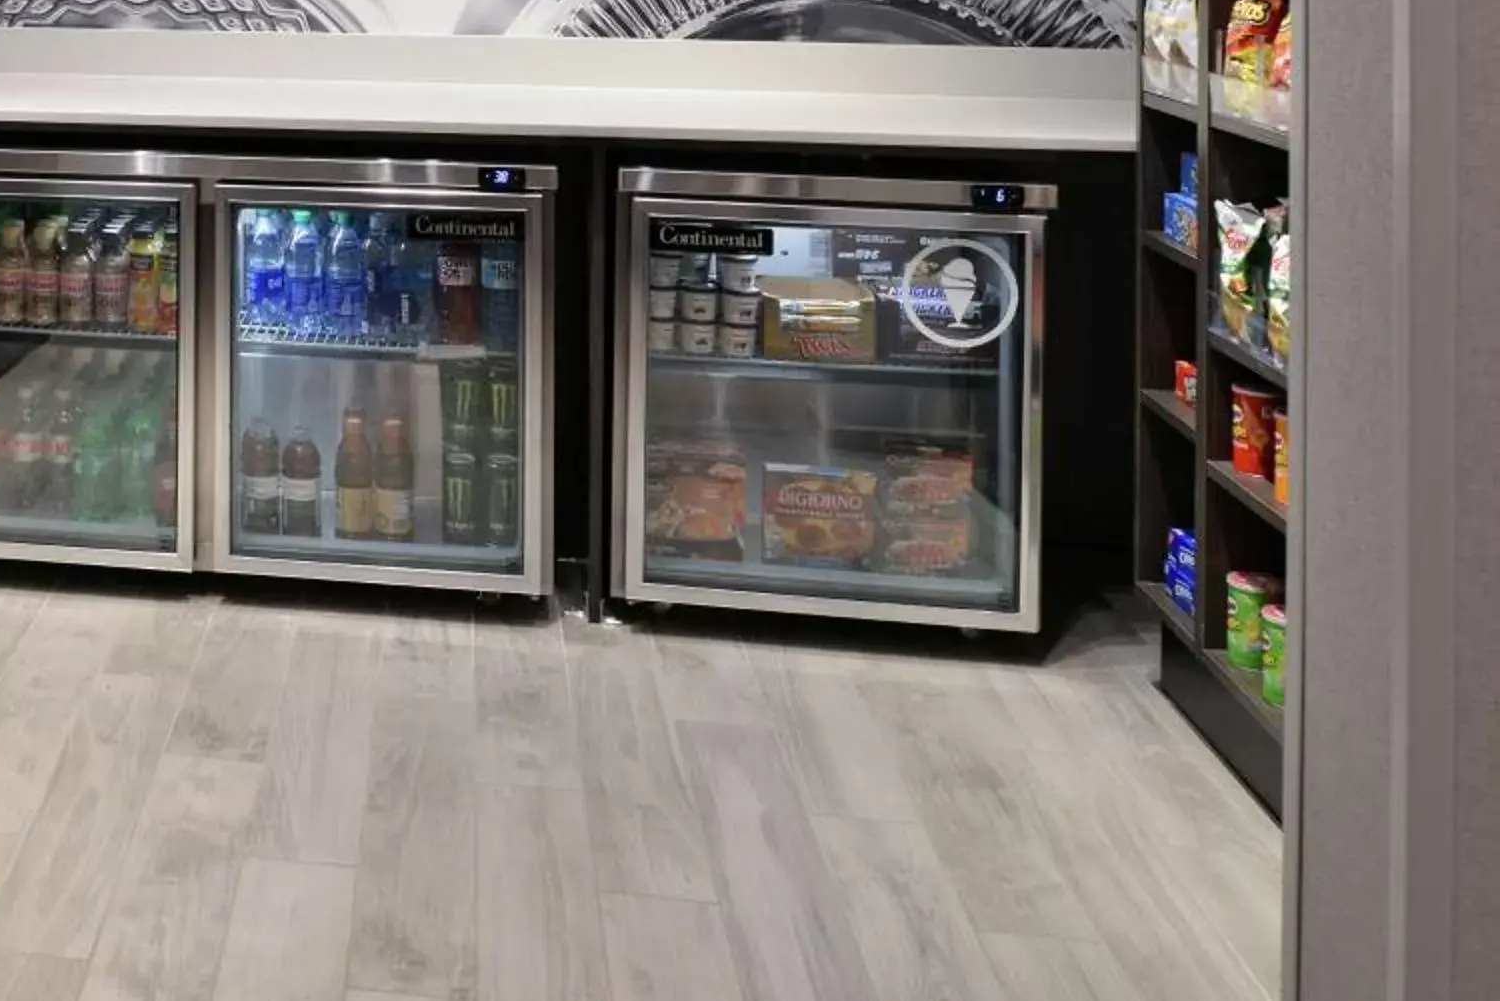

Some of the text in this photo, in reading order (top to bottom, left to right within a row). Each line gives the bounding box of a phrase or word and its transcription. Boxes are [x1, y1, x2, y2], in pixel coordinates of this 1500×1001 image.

[995, 188, 1005, 202] 6
[415, 214, 515, 236] Continental
[660, 224, 763, 248] Continental
